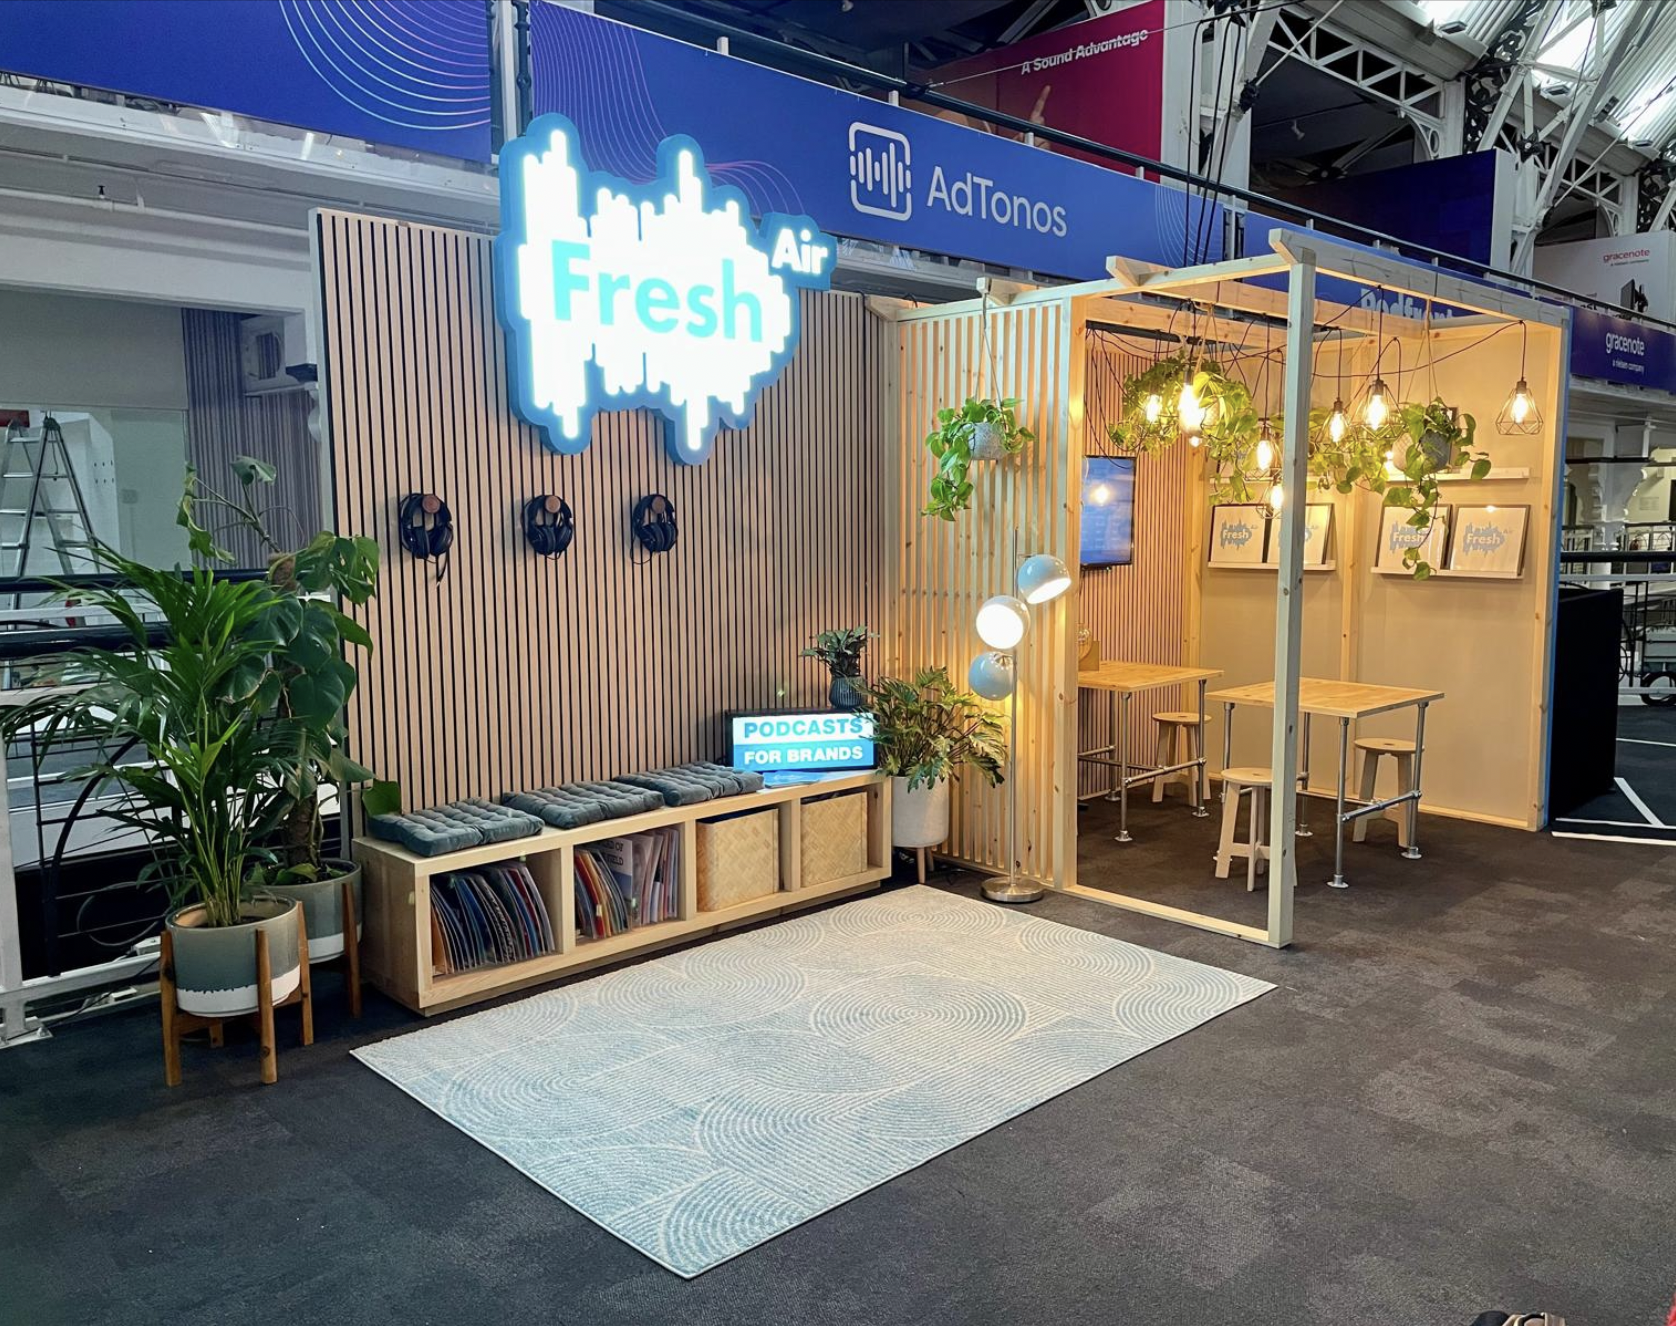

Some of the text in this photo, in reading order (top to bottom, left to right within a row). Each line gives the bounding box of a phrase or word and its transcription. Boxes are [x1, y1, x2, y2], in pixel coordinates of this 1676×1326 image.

[1021, 29, 1149, 75] A Sound Advantage
[927, 165, 1068, 238] AdTonos
[1603, 248, 1651, 264] gracenote
[551, 227, 829, 343] Fresh Air
[1605, 332, 1645, 356] gracenote
[1222, 529, 1250, 540] Fresh
[1392, 533, 1426, 544] Fresh
[1466, 533, 1501, 545] Fresh
[744, 717, 864, 739] PODCASTS
[744, 746, 864, 765] FOR BRANDS
